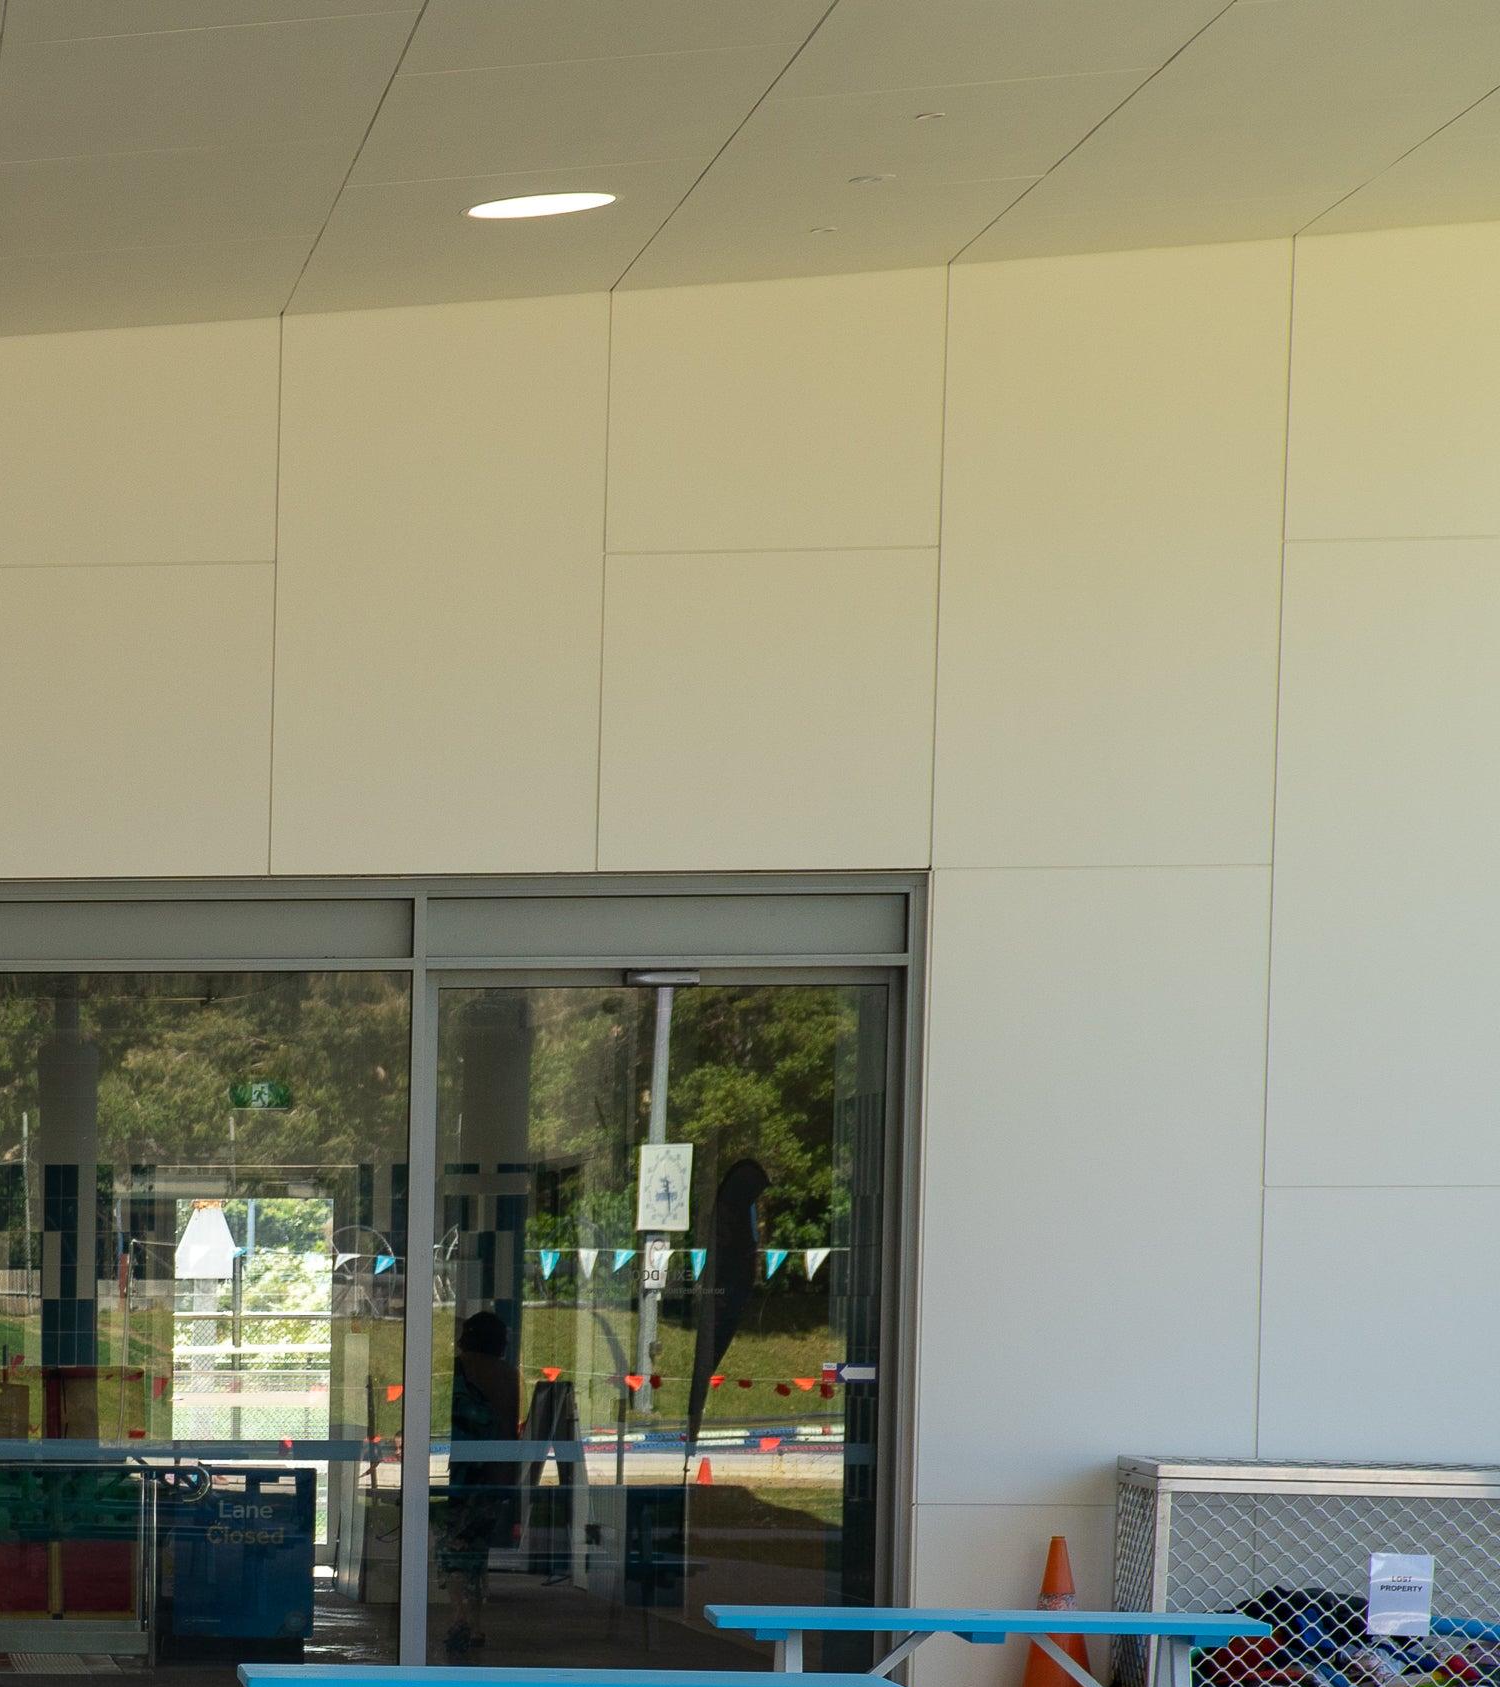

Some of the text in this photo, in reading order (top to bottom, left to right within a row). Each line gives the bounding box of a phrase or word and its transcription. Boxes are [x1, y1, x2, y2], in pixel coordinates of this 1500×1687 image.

[218, 1500, 274, 1519] Lane
[207, 1525, 285, 1545] Closed
[1392, 1575, 1412, 1583] LOST
[1380, 1584, 1423, 1592] PROPERTY
